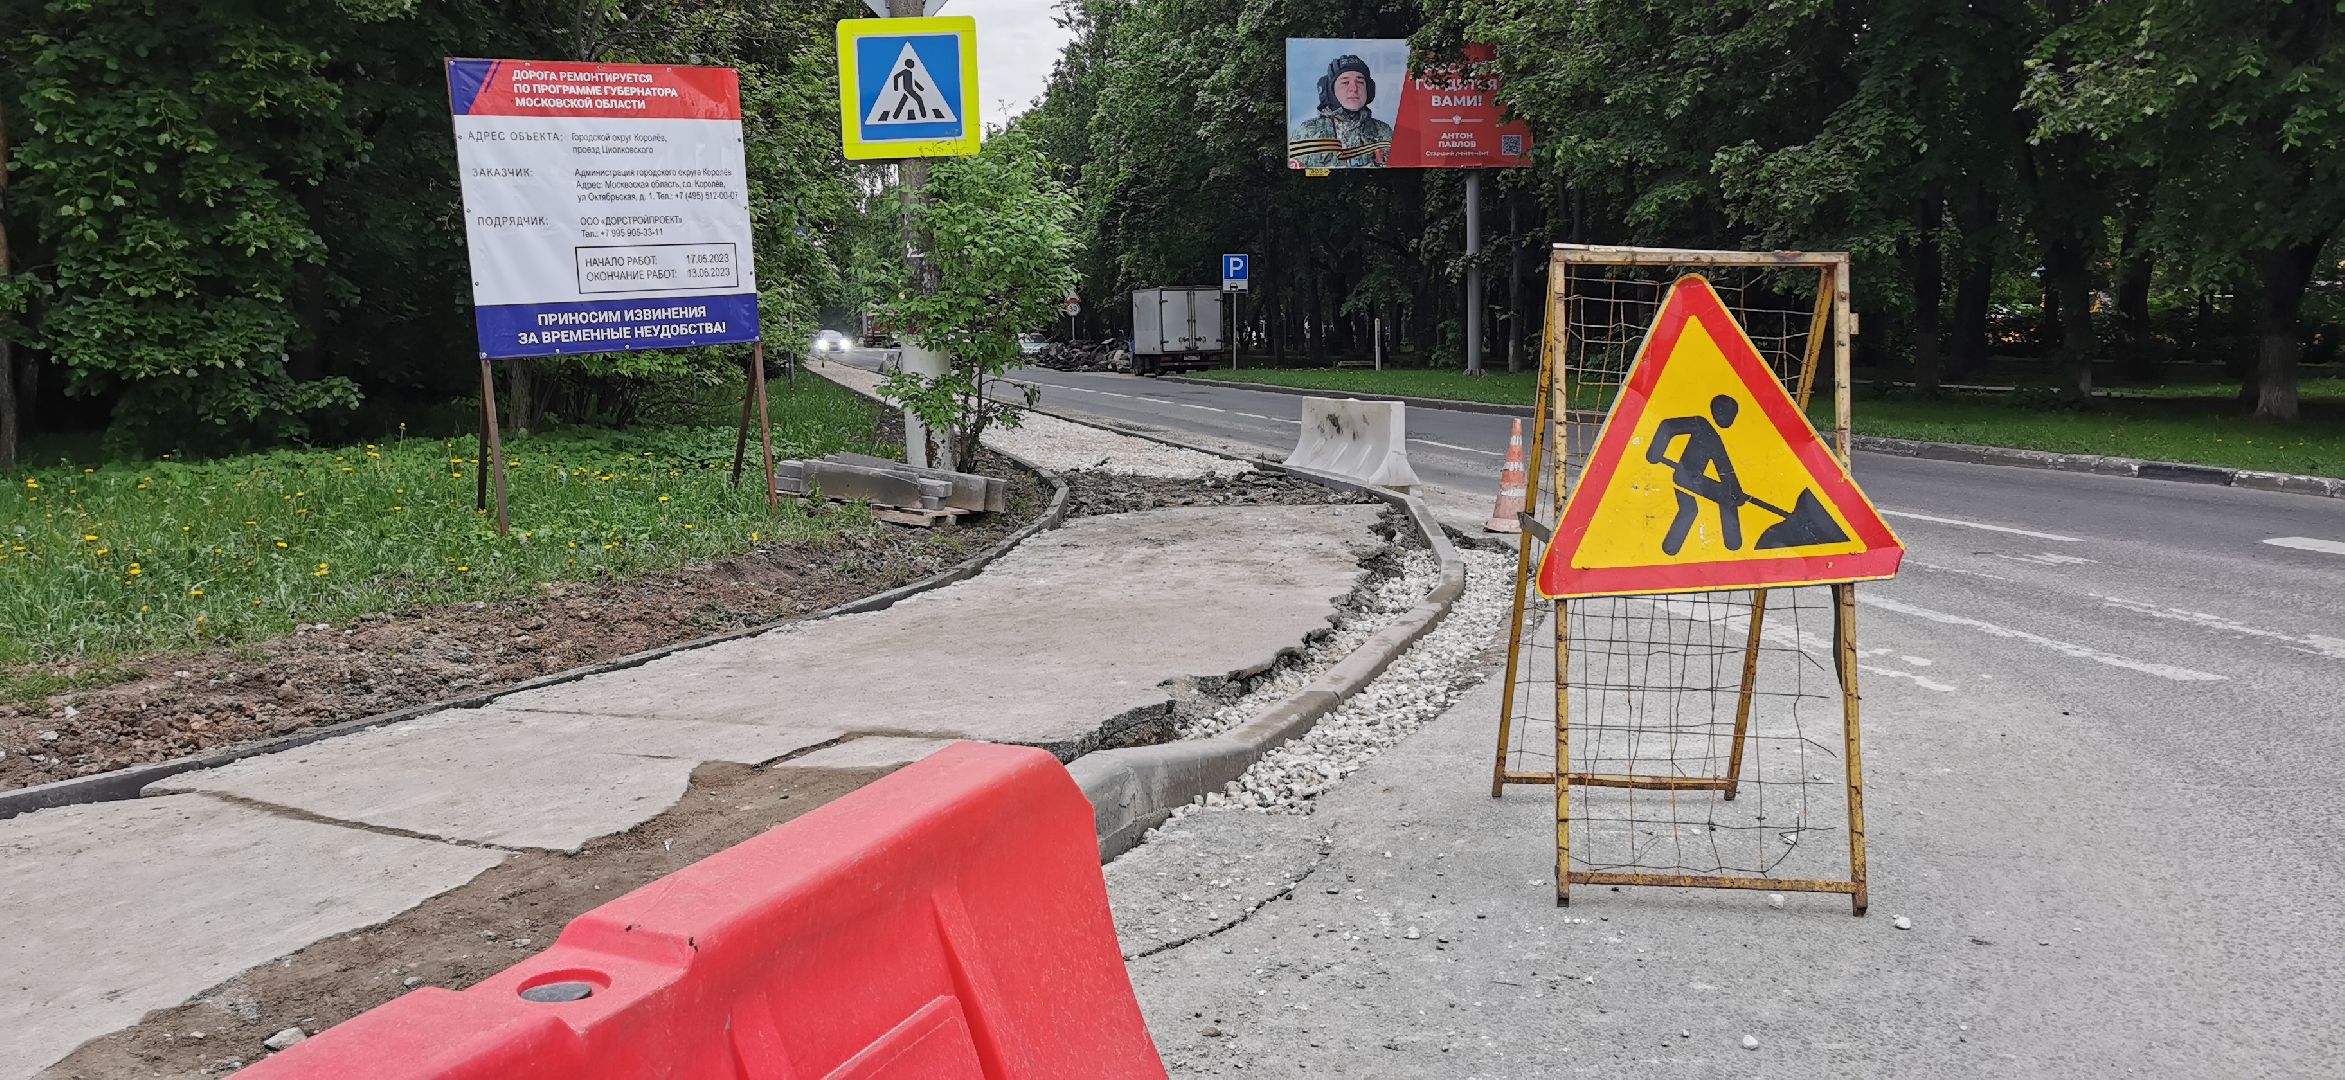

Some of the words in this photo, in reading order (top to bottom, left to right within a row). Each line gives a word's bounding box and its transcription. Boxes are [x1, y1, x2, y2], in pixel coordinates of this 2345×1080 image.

[512, 70, 557, 81] ДОРОГА
[560, 72, 652, 84] РЕМОНТИРУЕТСЯ
[514, 84, 530, 94] ПО
[533, 84, 602, 96] ПРОГРАММЕ
[604, 86, 678, 97] ГУБЕРНАТОРА
[516, 96, 592, 108] МОСКОВСКОЙ
[595, 99, 646, 110] ОБЛАСТИ
[1432, 95, 1482, 107] ВАМИ!
[468, 131, 506, 142] АДРЕС
[510, 132, 564, 142] ОБЪЕКТА:
[572, 132, 610, 142] Городской
[612, 134, 632, 144] округ
[634, 133, 668, 143] Королёв,
[572, 146, 600, 155] проезд
[602, 146, 654, 154] Циолковского
[472, 168, 534, 177] ЗАКАЗЧИК:
[574, 168, 635, 178] Администрация
[636, 170, 676, 178] городского
[678, 170, 702, 178] округа
[576, 180, 602, 190] Адрес:
[650, 180, 682, 189] область,
[694, 180, 726, 188] Королёв,
[656, 192, 674, 200] Тел.:
[676, 192, 683, 200] +7
[685, 192, 704, 201] (495)
[478, 216, 548, 228] ПОДРЯДЧИК:
[601, 214, 682, 226] «ДОРСТРОЙПРОЕКТ»
[600, 229, 609, 237] +7
[611, 228, 625, 237] 995
[627, 228, 663, 237] 905-33-11
[586, 256, 624, 267] НАЧАЛО
[628, 256, 658, 266] РАБОТ:
[686, 254, 730, 264] 17.05.2023
[586, 270, 645, 282] ОКОНЧАНИЕ
[647, 270, 677, 280] РАБОТ:
[538, 310, 621, 326] ПРИНОСИМ
[624, 306, 706, 322] ИЗВИНЕНИЯ
[518, 332, 539, 344] ЗА
[542, 326, 631, 344] ВРЕМЕННЫЕ
[634, 322, 726, 339] НЕУДОБСТВА!
